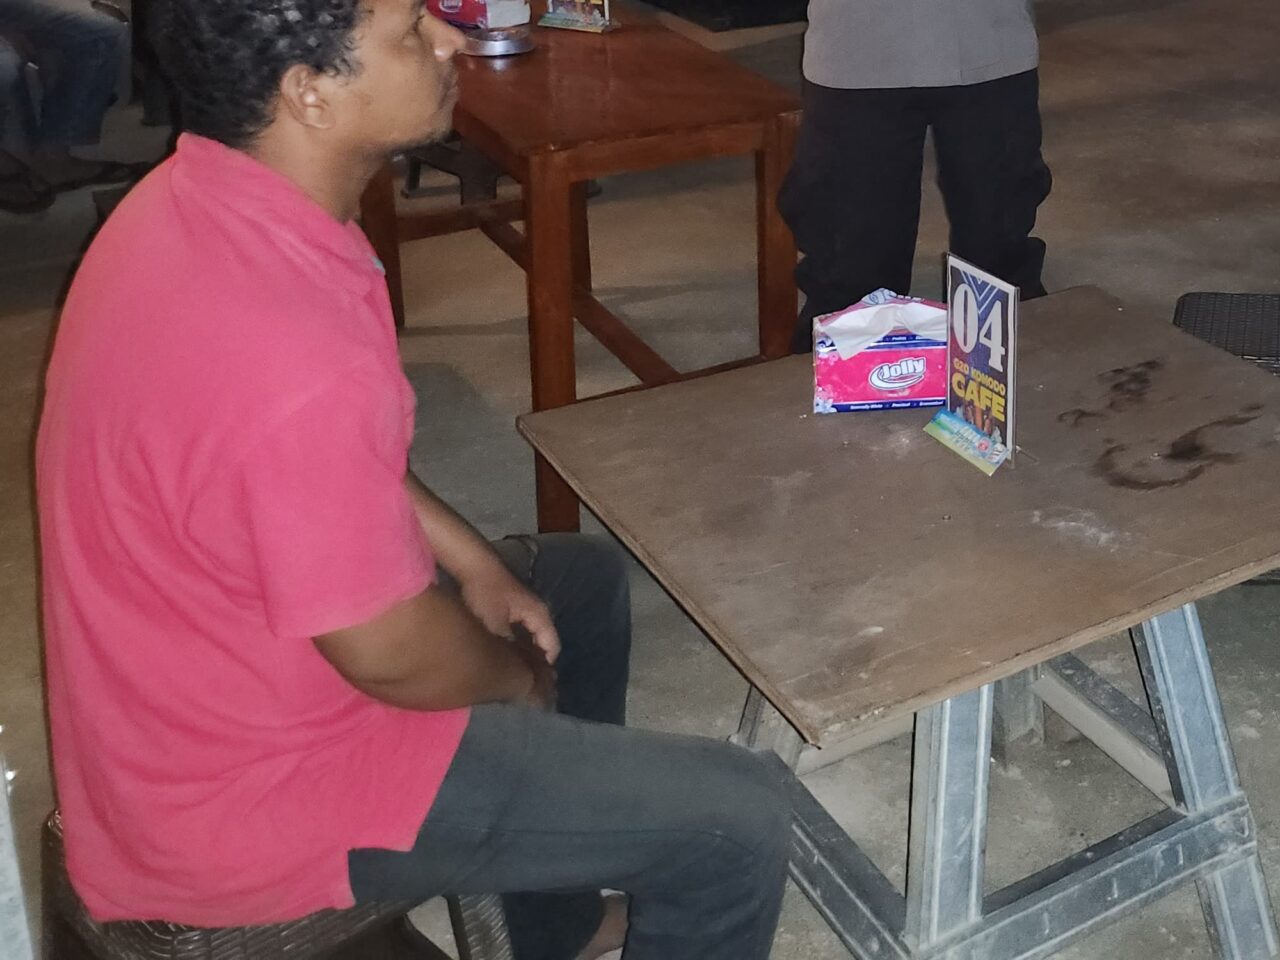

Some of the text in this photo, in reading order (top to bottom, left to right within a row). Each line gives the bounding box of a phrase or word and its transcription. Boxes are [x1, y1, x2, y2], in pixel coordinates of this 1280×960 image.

[953, 283, 1006, 372] 04
[876, 358, 925, 381] Jolly
[951, 372, 1006, 422] CAFE
